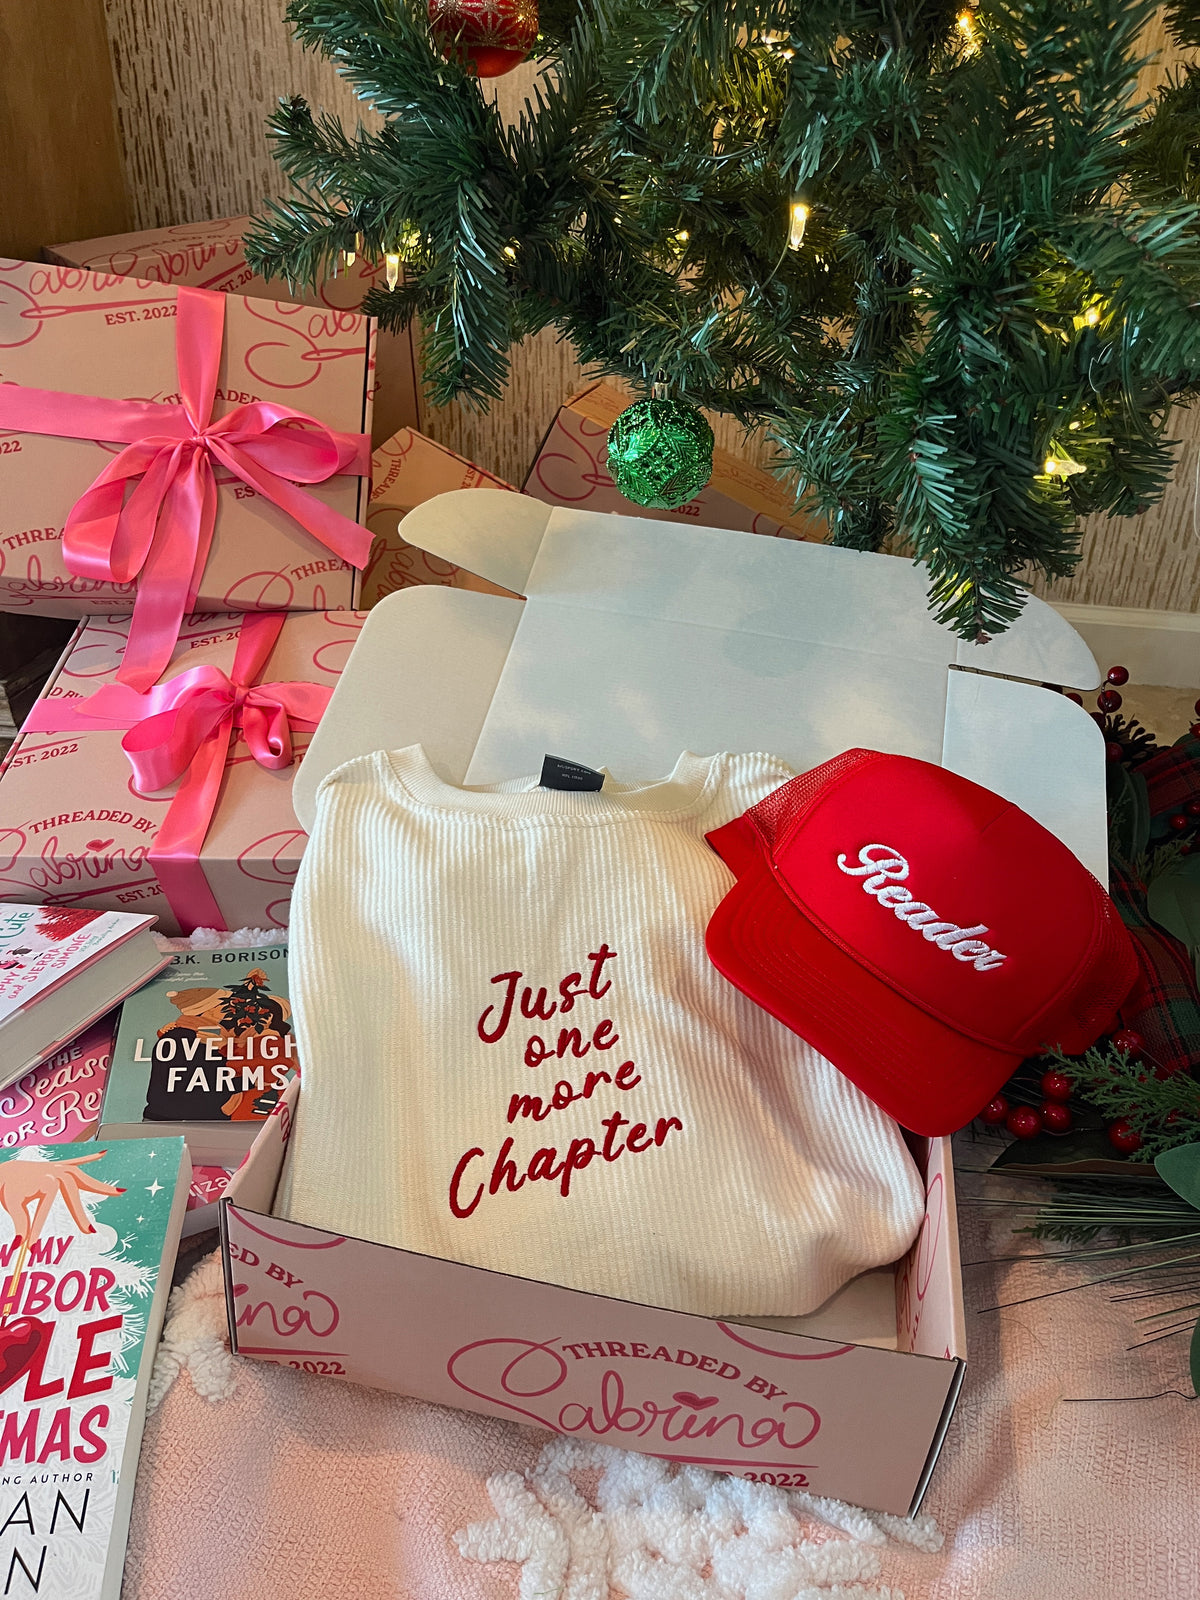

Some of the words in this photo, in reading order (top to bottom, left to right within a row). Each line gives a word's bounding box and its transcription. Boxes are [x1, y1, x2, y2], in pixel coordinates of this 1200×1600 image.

[105, 309, 140, 326] EST.
[143, 304, 177, 321] 2022
[190, 635, 223, 649] EST.
[41, 743, 79, 761] 2022
[28, 809, 134, 834] THREADED
[132, 817, 157, 834] BY
[116, 889, 149, 903] EST.
[837, 843, 1008, 972] Reader
[21, 945, 63, 983] SIERRA
[50, 932, 93, 969] SIMONE
[477, 943, 618, 1044] Just
[133, 1034, 297, 1063] LOVELIGH
[524, 1018, 620, 1068] one
[44, 1046, 84, 1070] THE
[166, 1063, 290, 1093] FARMS
[506, 1060, 642, 1124] more
[0, 1120, 38, 1149] OR
[449, 1110, 683, 1219] Chapter
[27, 1235, 75, 1268] MY
[264, 1261, 304, 1290] BY
[561, 1340, 742, 1382] THREADED
[743, 1374, 788, 1402] BY
[29, 1472, 95, 1484] AUTHOR
